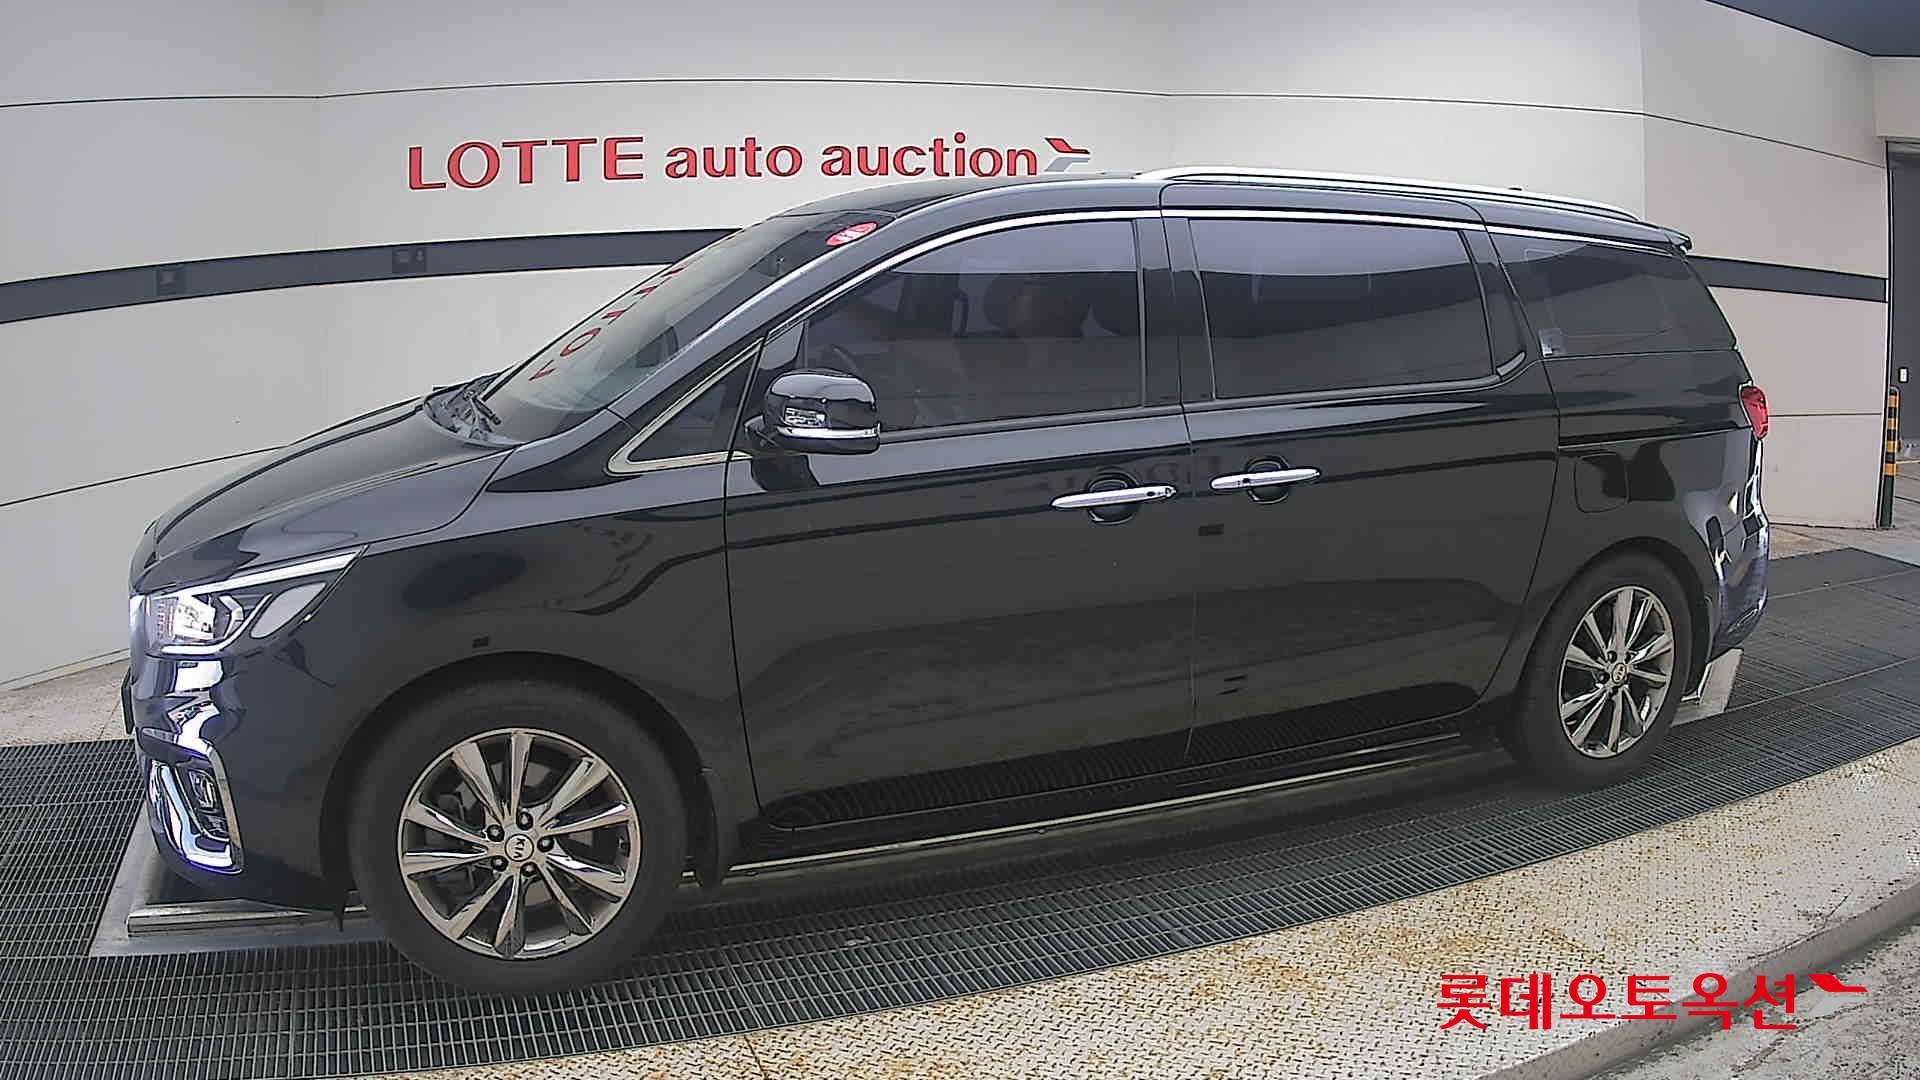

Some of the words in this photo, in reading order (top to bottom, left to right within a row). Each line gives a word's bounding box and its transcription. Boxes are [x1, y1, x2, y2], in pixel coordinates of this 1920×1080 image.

[409, 137, 644, 190] LOTTE
[665, 138, 802, 178] auto
[822, 132, 1039, 178] auction
[513, 838, 526, 859] KIA
